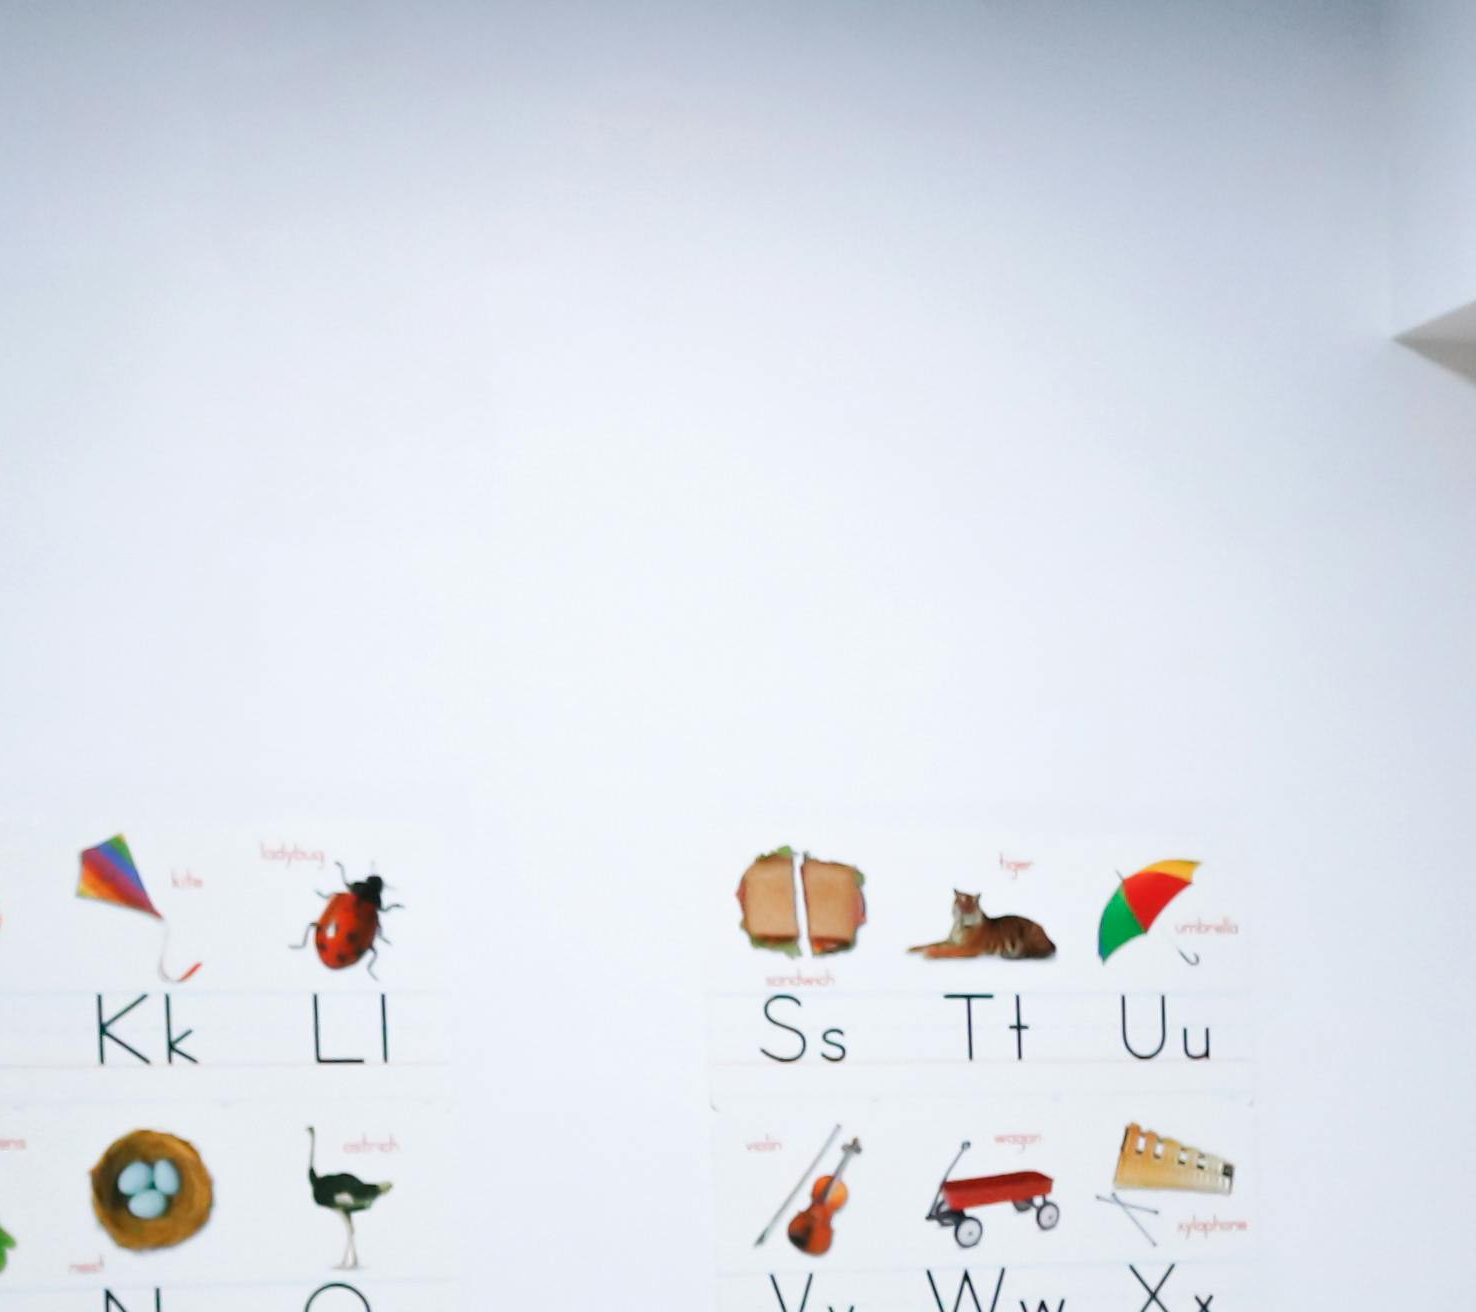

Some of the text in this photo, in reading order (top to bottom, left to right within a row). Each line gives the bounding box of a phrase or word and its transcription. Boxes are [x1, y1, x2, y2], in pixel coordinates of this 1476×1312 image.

[259, 841, 326, 871] ladybug
[998, 852, 1034, 879] tiger
[170, 870, 205, 889] kite
[1174, 916, 1240, 935] umbrella
[765, 969, 836, 988] sandwich
[341, 1133, 400, 1155] ostrich
[745, 1133, 783, 1153] violin
[993, 1133, 1042, 1152] wagon
[1177, 1214, 1249, 1240] xylophone
